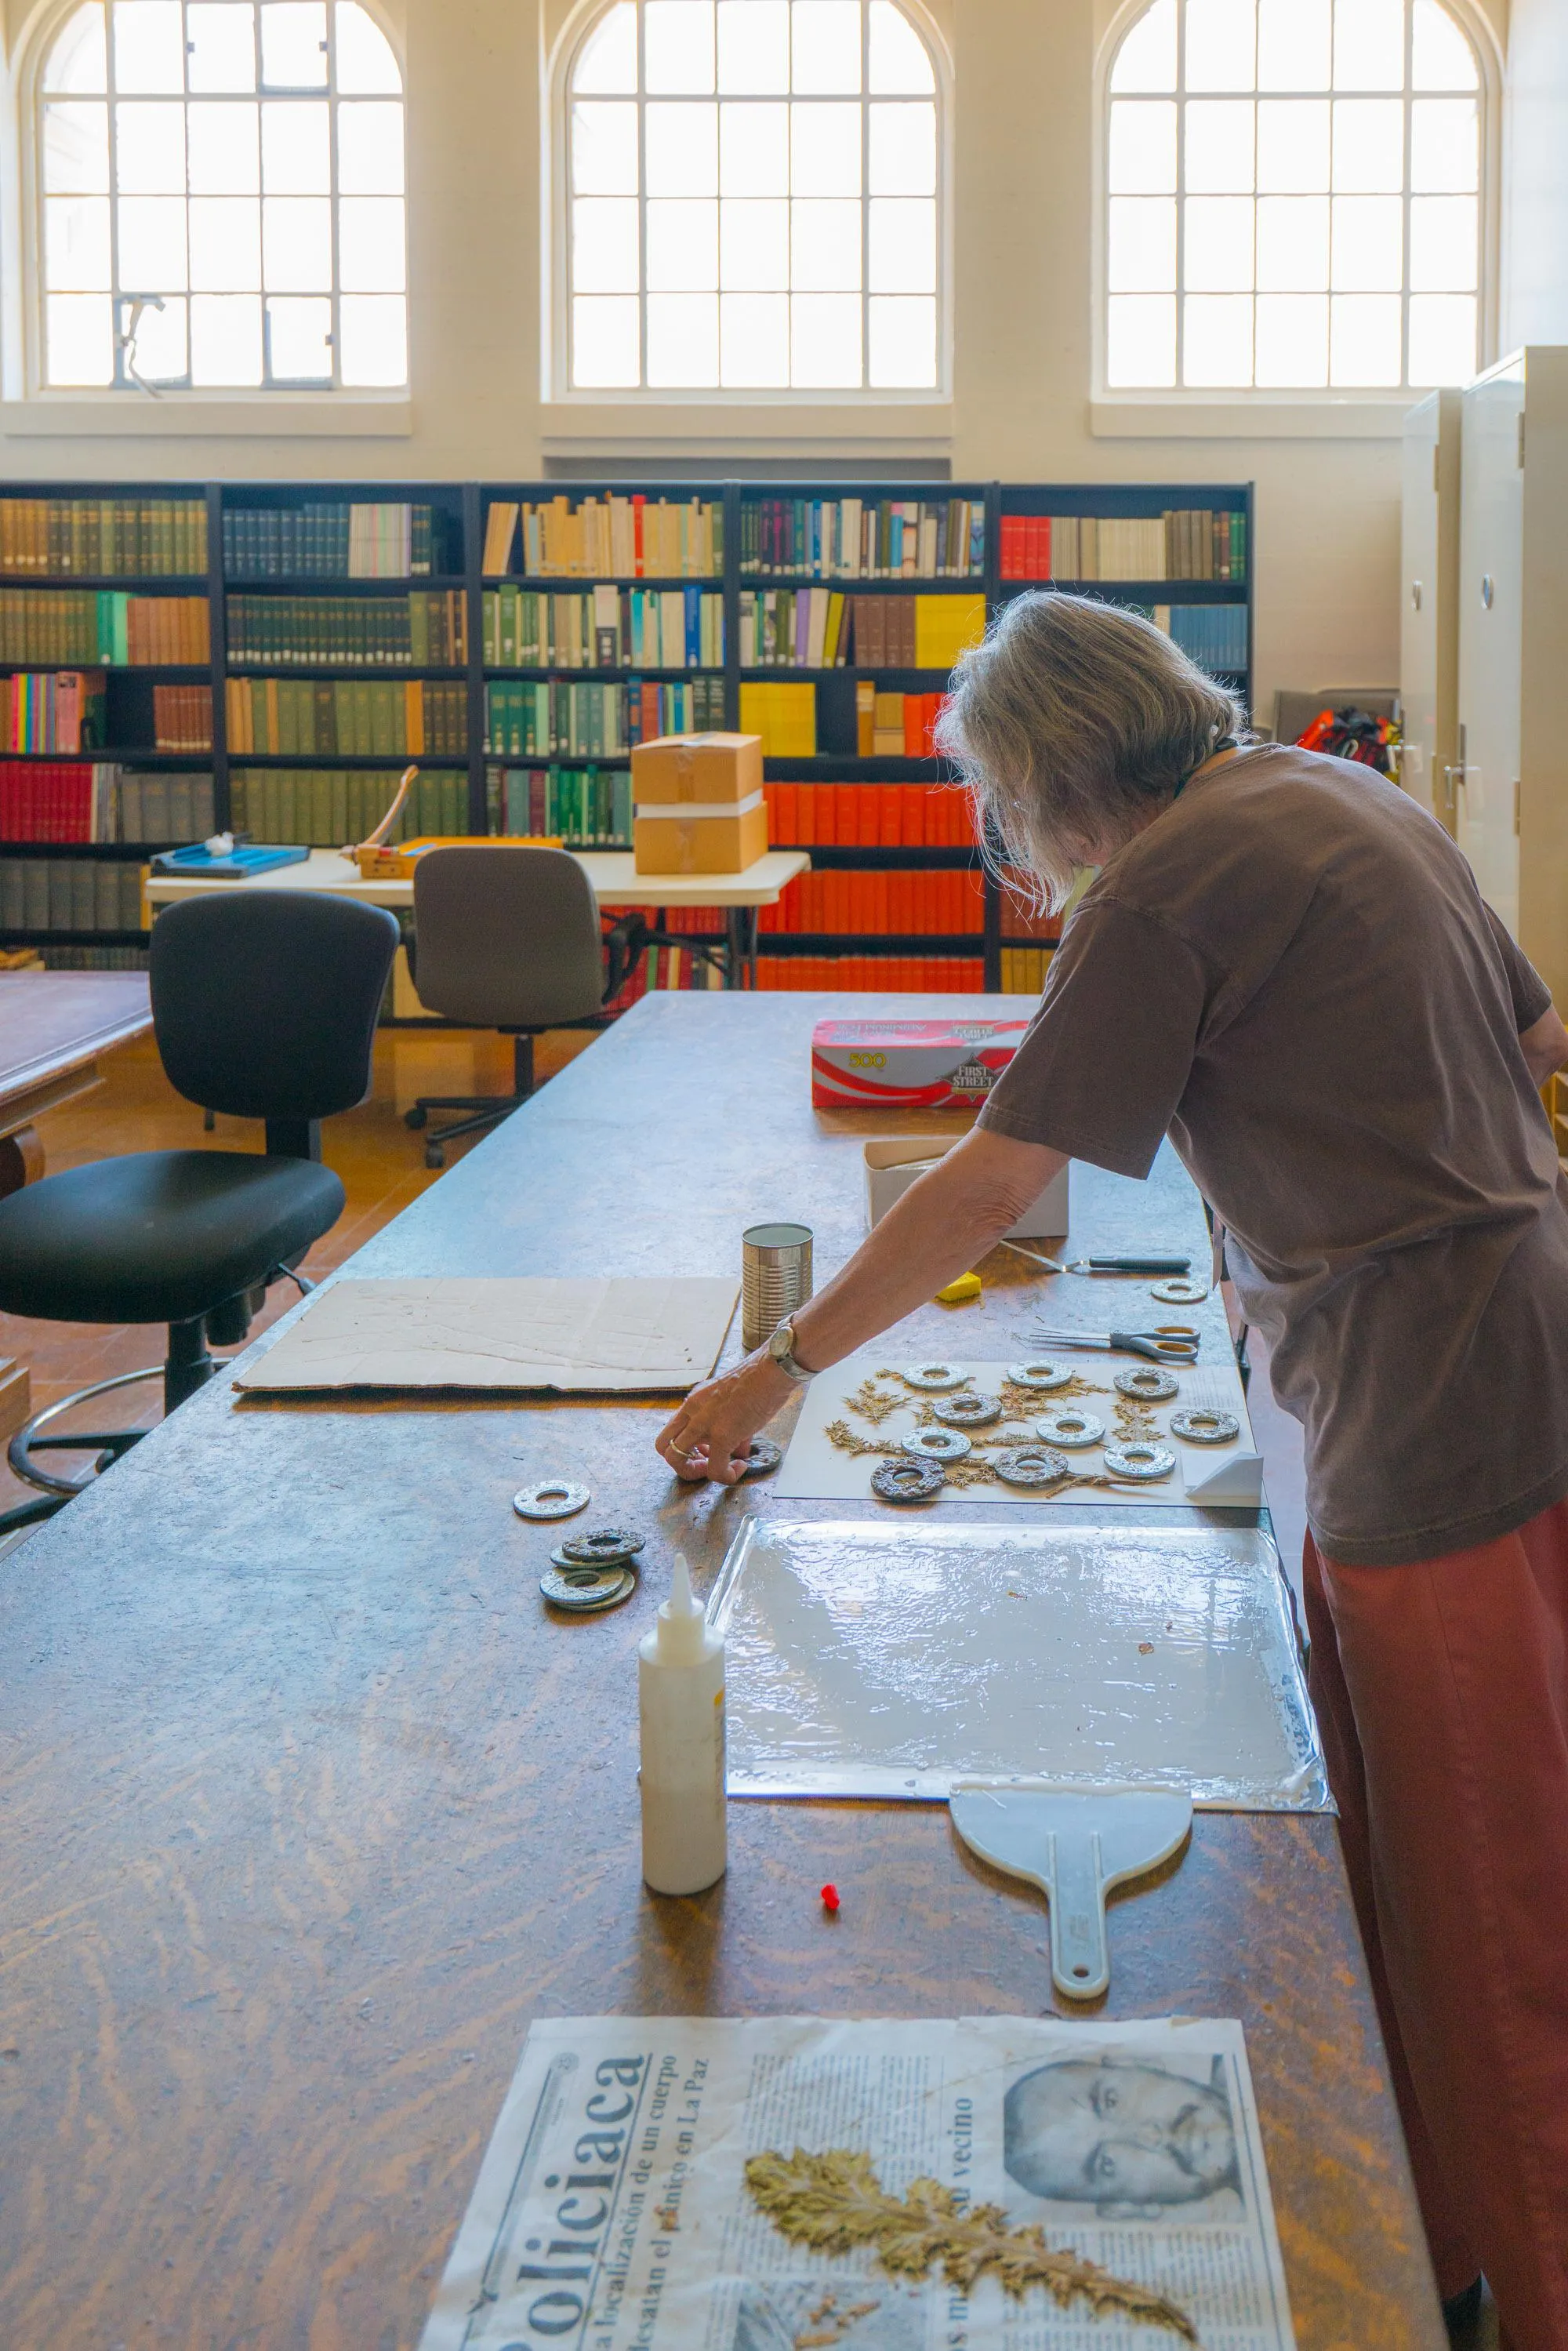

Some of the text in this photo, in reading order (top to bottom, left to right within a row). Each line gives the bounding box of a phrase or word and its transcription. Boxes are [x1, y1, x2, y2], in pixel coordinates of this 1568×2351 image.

[848, 1053, 887, 1068] 500
[958, 1065, 989, 1077] FIRST
[953, 1076, 994, 1088] STREET
[682, 2059, 708, 2091] Paz
[646, 2055, 677, 2120] cuerpo
[677, 2100, 699, 2123] La
[641, 2128, 660, 2151] un
[673, 2131, 693, 2155] en
[946, 2098, 974, 2178] vecino
[629, 2159, 653, 2184] de
[594, 2193, 644, 2326] localización
[649, 2240, 671, 2258] el
